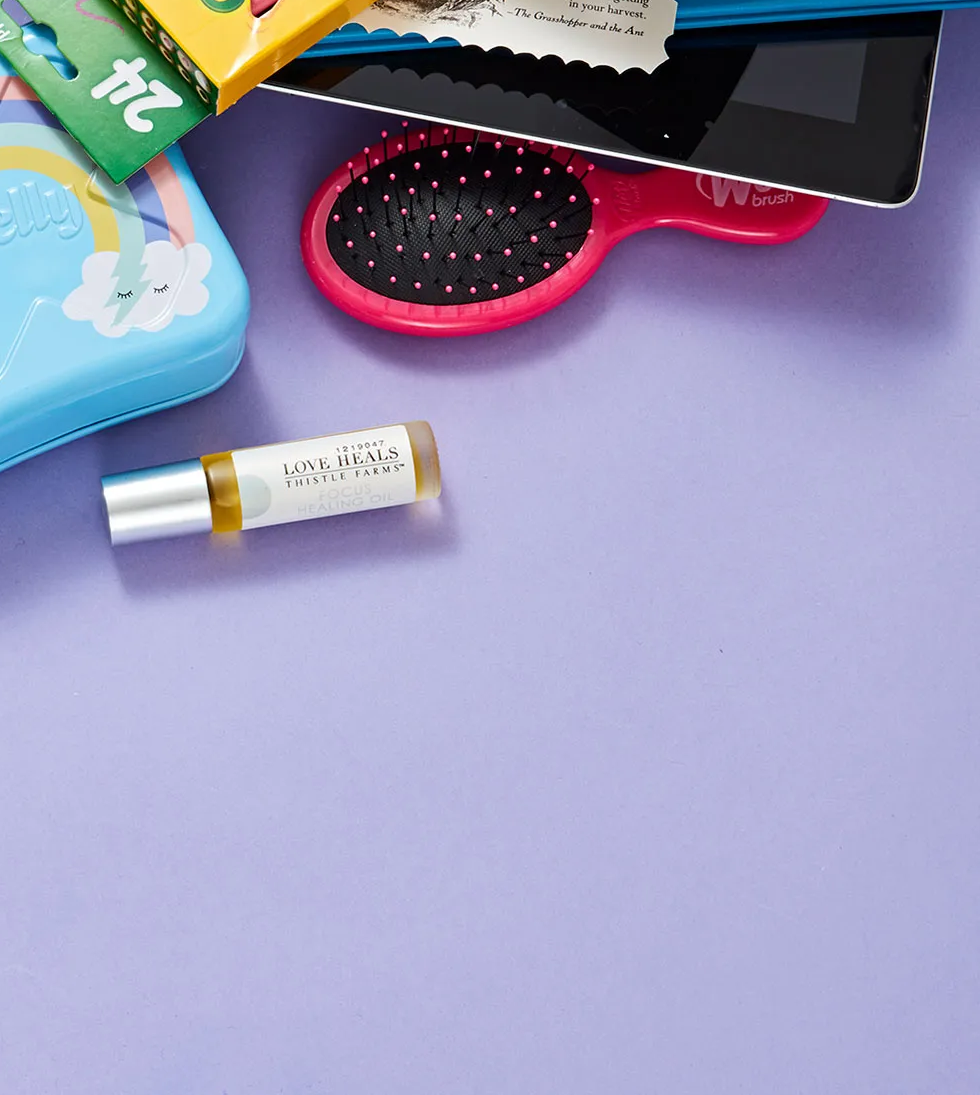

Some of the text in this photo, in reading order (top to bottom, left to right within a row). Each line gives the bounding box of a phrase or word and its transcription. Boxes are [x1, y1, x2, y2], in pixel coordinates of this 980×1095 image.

[569, 0, 648, 20] in your harvest.
[533, 10, 589, 28] Grasshopper
[590, 21, 608, 32] and
[609, 23, 622, 33] the
[624, 26, 645, 37] Ant
[91, 56, 184, 134] 24
[752, 190, 794, 208] brush
[336, 439, 385, 454] 1219047
[283, 446, 400, 476] LOVE HEALS
[285, 471, 347, 489] THISTLE
[319, 484, 372, 502] FOCUS
[297, 492, 395, 516] HEALING OIL
